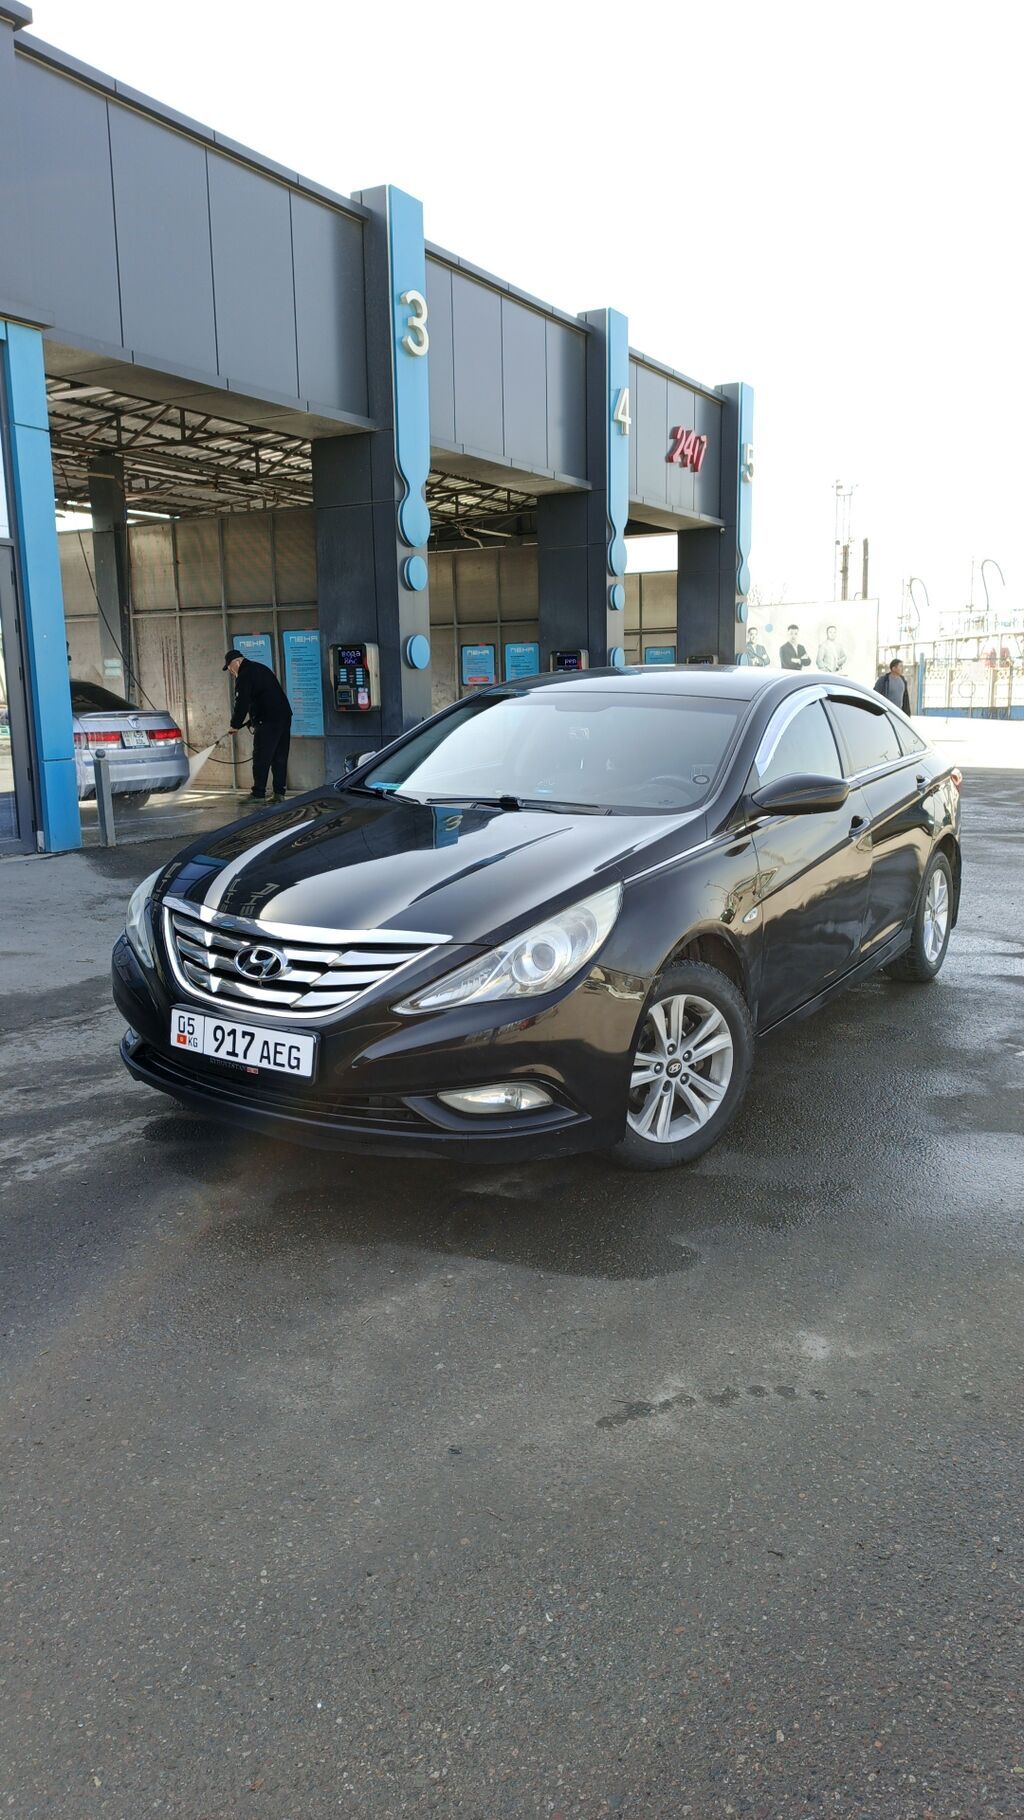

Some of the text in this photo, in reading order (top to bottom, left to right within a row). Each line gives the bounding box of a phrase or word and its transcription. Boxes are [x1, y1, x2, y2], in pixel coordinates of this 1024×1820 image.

[400, 290, 429, 356] 3
[613, 388, 632, 435] 4
[742, 443, 754, 483] 5
[239, 640, 266, 648] ПЕНА
[289, 635, 319, 643] ПЕНА
[178, 1015, 195, 1036] 05
[188, 1037, 199, 1048] KG
[213, 1025, 301, 1071] 917 AEG
